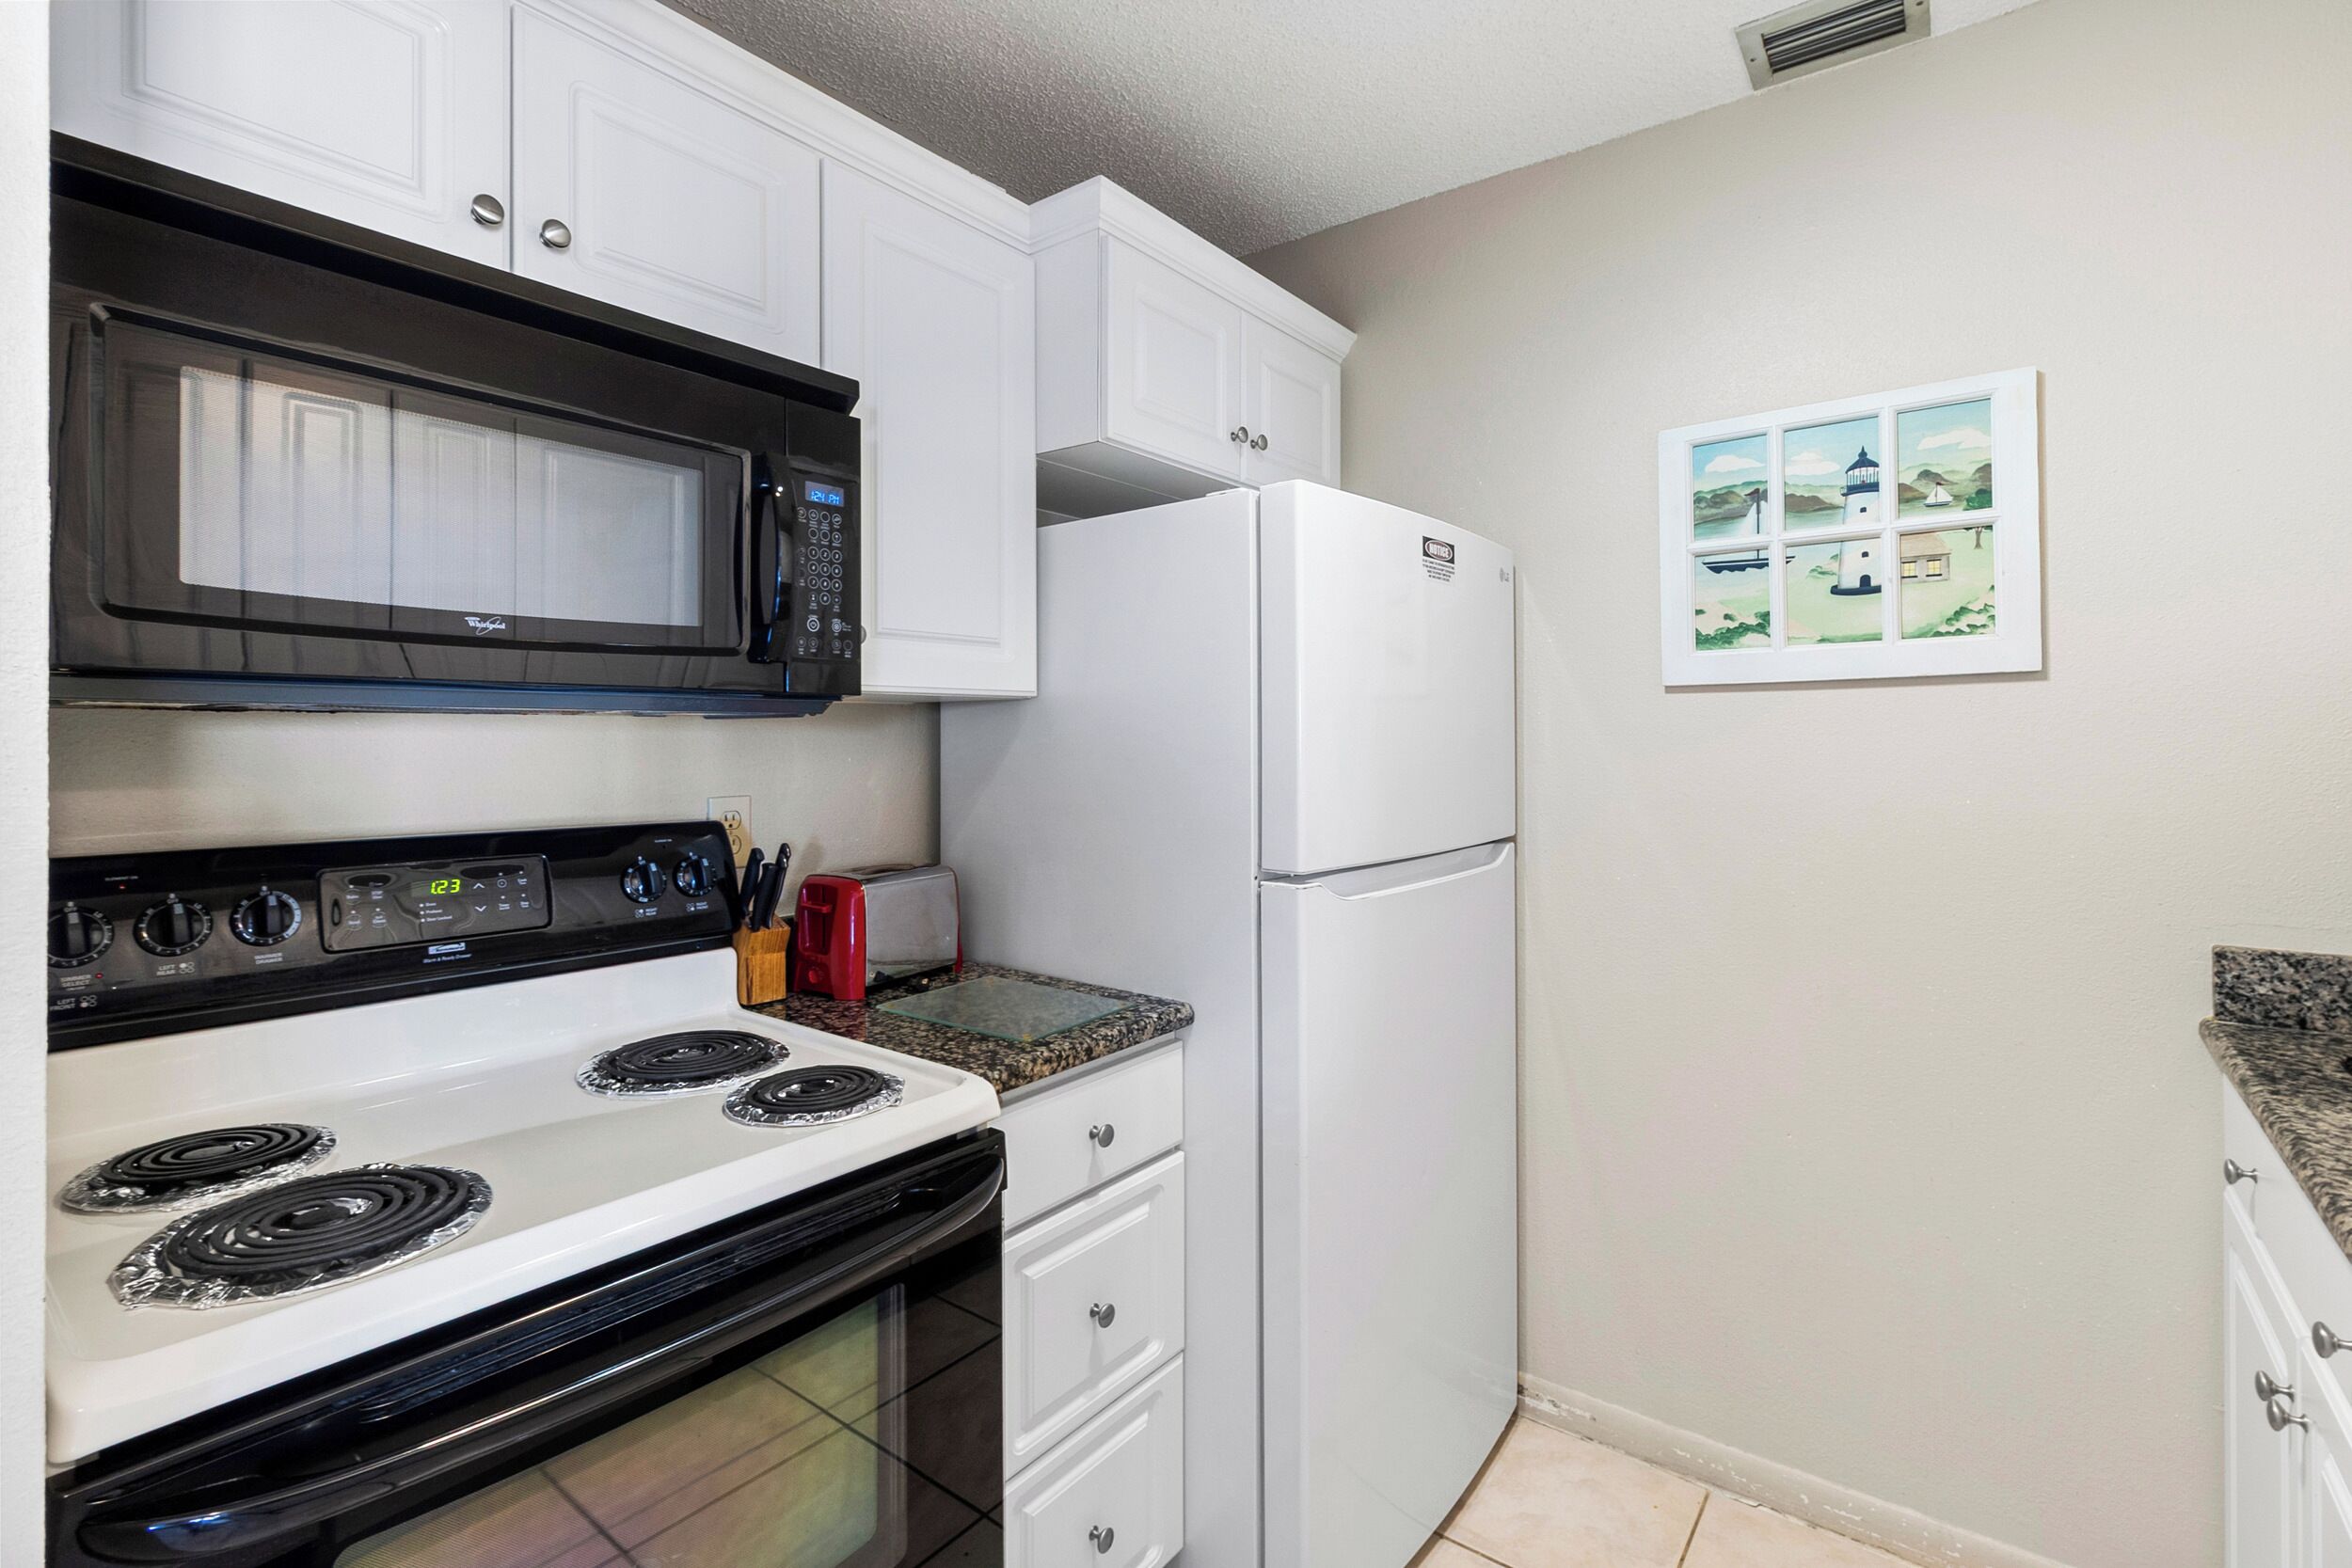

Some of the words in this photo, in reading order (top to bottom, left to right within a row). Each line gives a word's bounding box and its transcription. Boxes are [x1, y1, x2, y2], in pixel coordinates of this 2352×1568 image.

[828, 494, 839, 505] PM
[1429, 543, 1449, 558] NOTICE
[464, 617, 506, 630] Whirlpool
